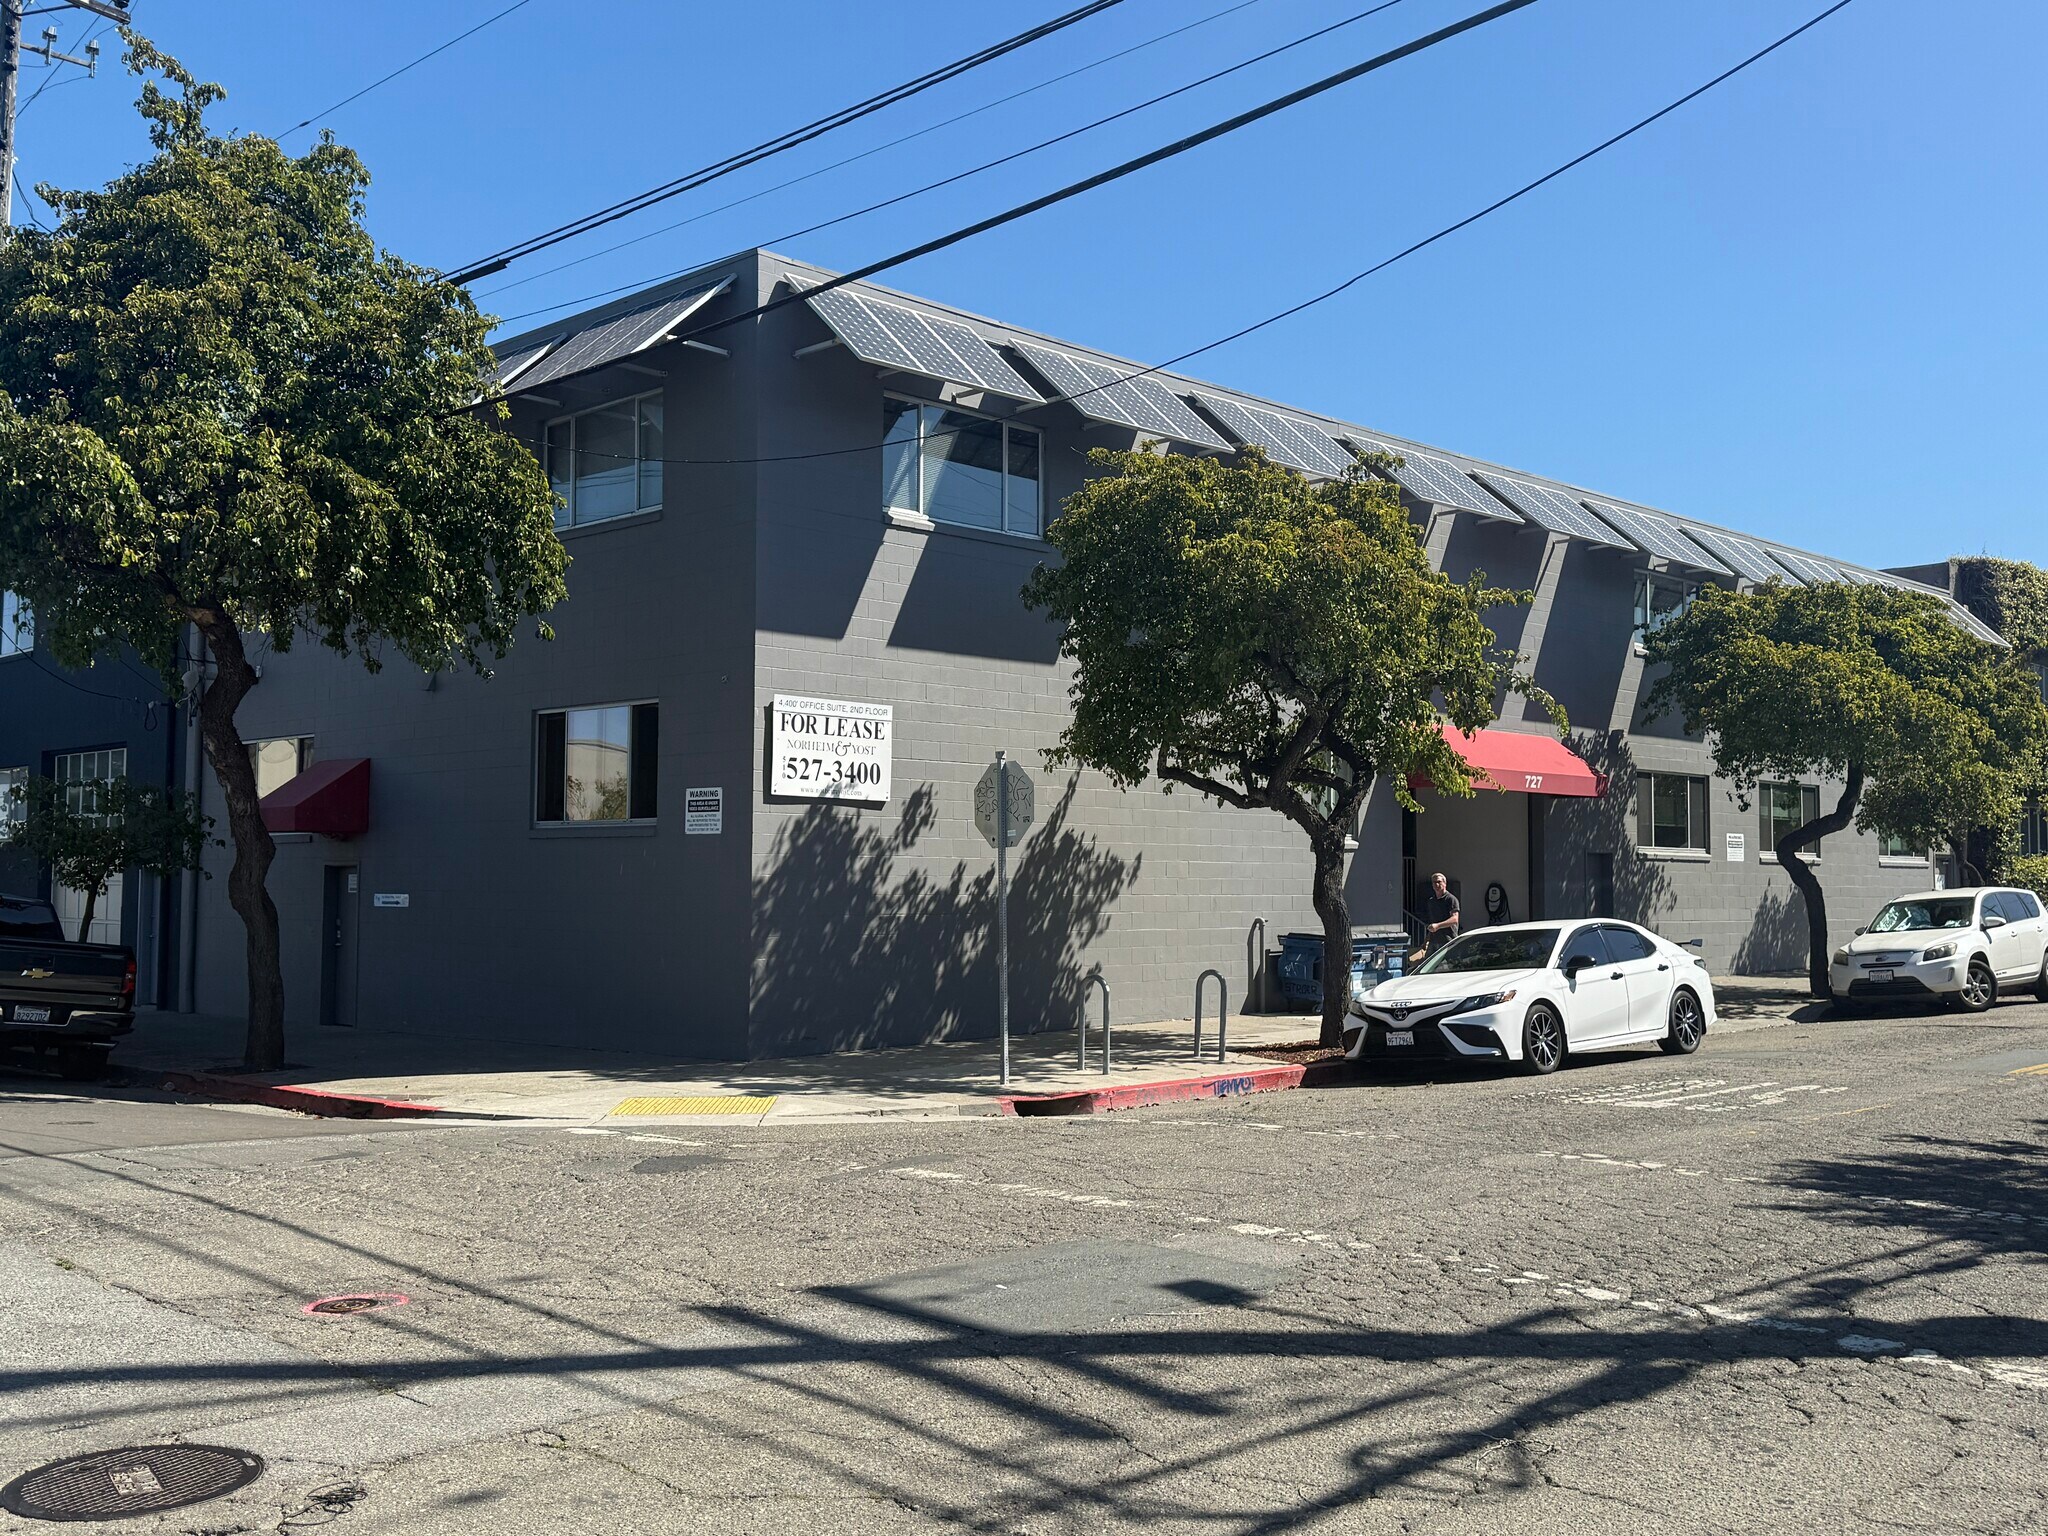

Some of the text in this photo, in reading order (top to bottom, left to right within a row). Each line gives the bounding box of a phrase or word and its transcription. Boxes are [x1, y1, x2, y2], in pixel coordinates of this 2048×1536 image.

[800, 701, 825, 711] OFFICE
[826, 703, 848, 713] SUITE,
[850, 706, 864, 714] 2ND
[864, 708, 888, 716] FLOOR
[780, 713, 885, 740] FOR LEASE
[787, 739, 876, 757] NORHEIM & YOST
[786, 757, 881, 785] 527-3400
[1525, 775, 1543, 788] 727
[689, 790, 719, 798] WARNING
